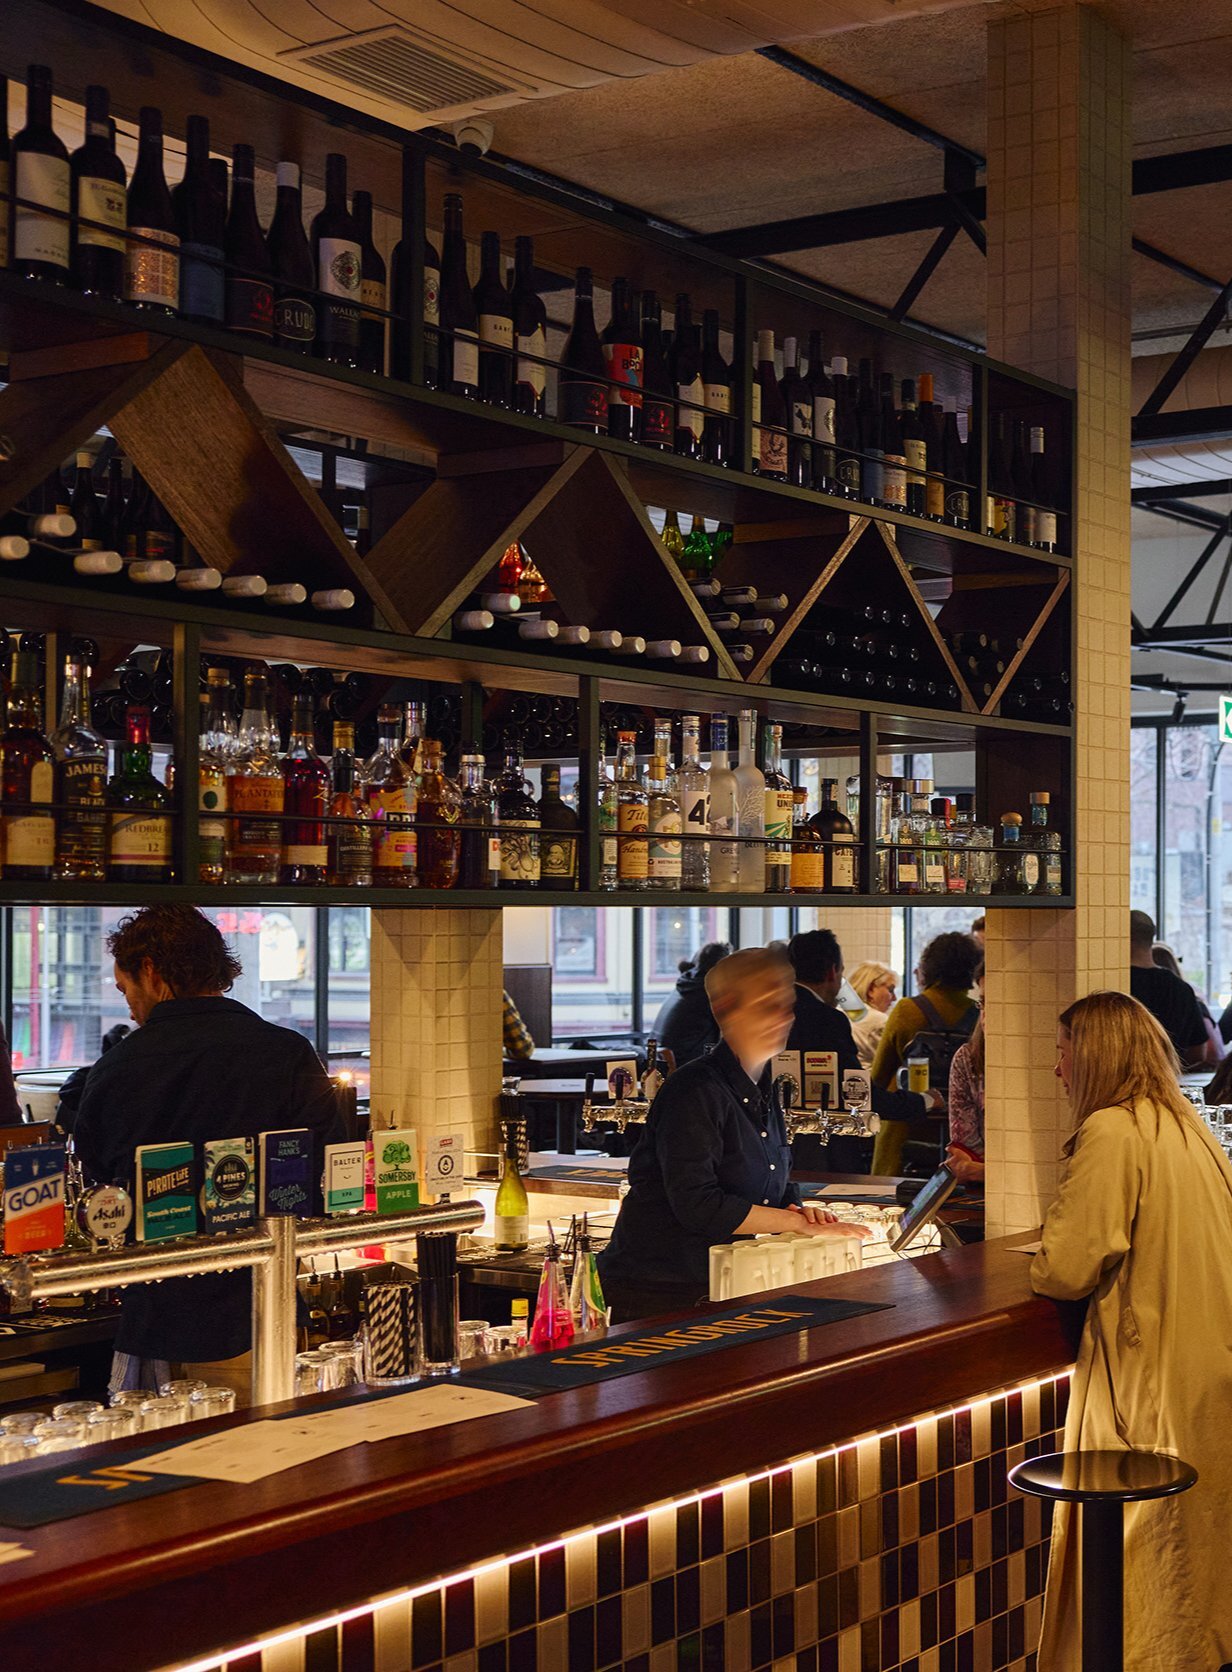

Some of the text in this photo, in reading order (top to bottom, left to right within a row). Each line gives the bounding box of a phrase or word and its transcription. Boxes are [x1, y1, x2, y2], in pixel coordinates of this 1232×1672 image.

[147, 843, 160, 853] 12
[333, 1156, 362, 1167] BALTER
[222, 1171, 246, 1183] PINES
[378, 1170, 417, 1184] SOMERSBY
[8, 1178, 61, 1212] GOAT
[385, 1189, 412, 1200] APPLE
[92, 1204, 125, 1221] Asahi
[211, 1210, 251, 1224] PACIFIC ALE
